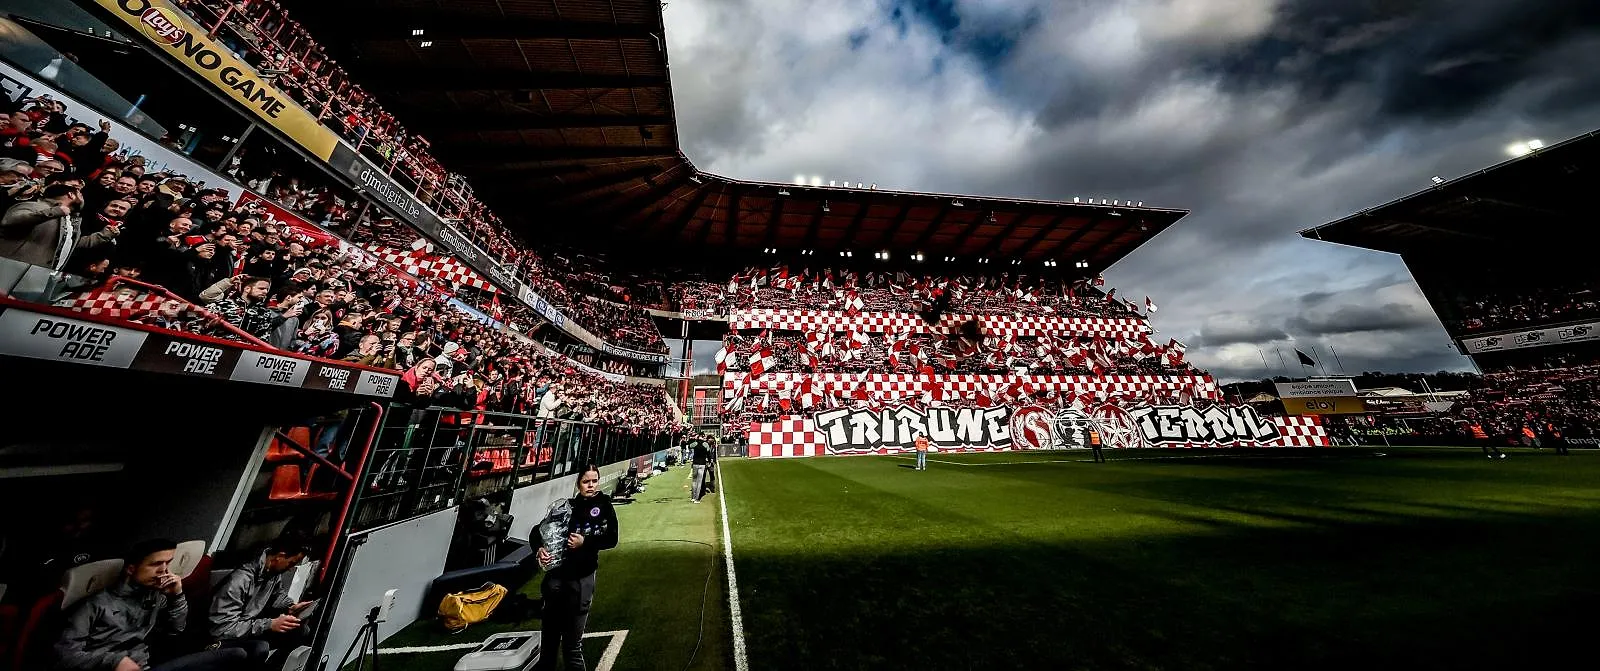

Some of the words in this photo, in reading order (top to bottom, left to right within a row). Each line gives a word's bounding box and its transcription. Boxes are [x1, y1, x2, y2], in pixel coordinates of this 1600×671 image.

[142, 10, 183, 40] Lay's
[172, 33, 221, 70] NO
[219, 66, 286, 118] GAME
[361, 169, 420, 218] djmdigital.be
[31, 319, 117, 346] POWER
[59, 341, 110, 361] ADE
[165, 341, 223, 361] POWER
[184, 358, 217, 375] ADE
[256, 356, 297, 372] POWER
[269, 371, 292, 383] ADE
[319, 366, 350, 380] POWER
[368, 375, 392, 386] POWER
[329, 379, 347, 389] ADE
[375, 385, 390, 394] ADE
[1306, 399, 1336, 411] eloy
[816, 405, 1013, 449] TRIBUNE
[1131, 406, 1276, 442] TERRIL
